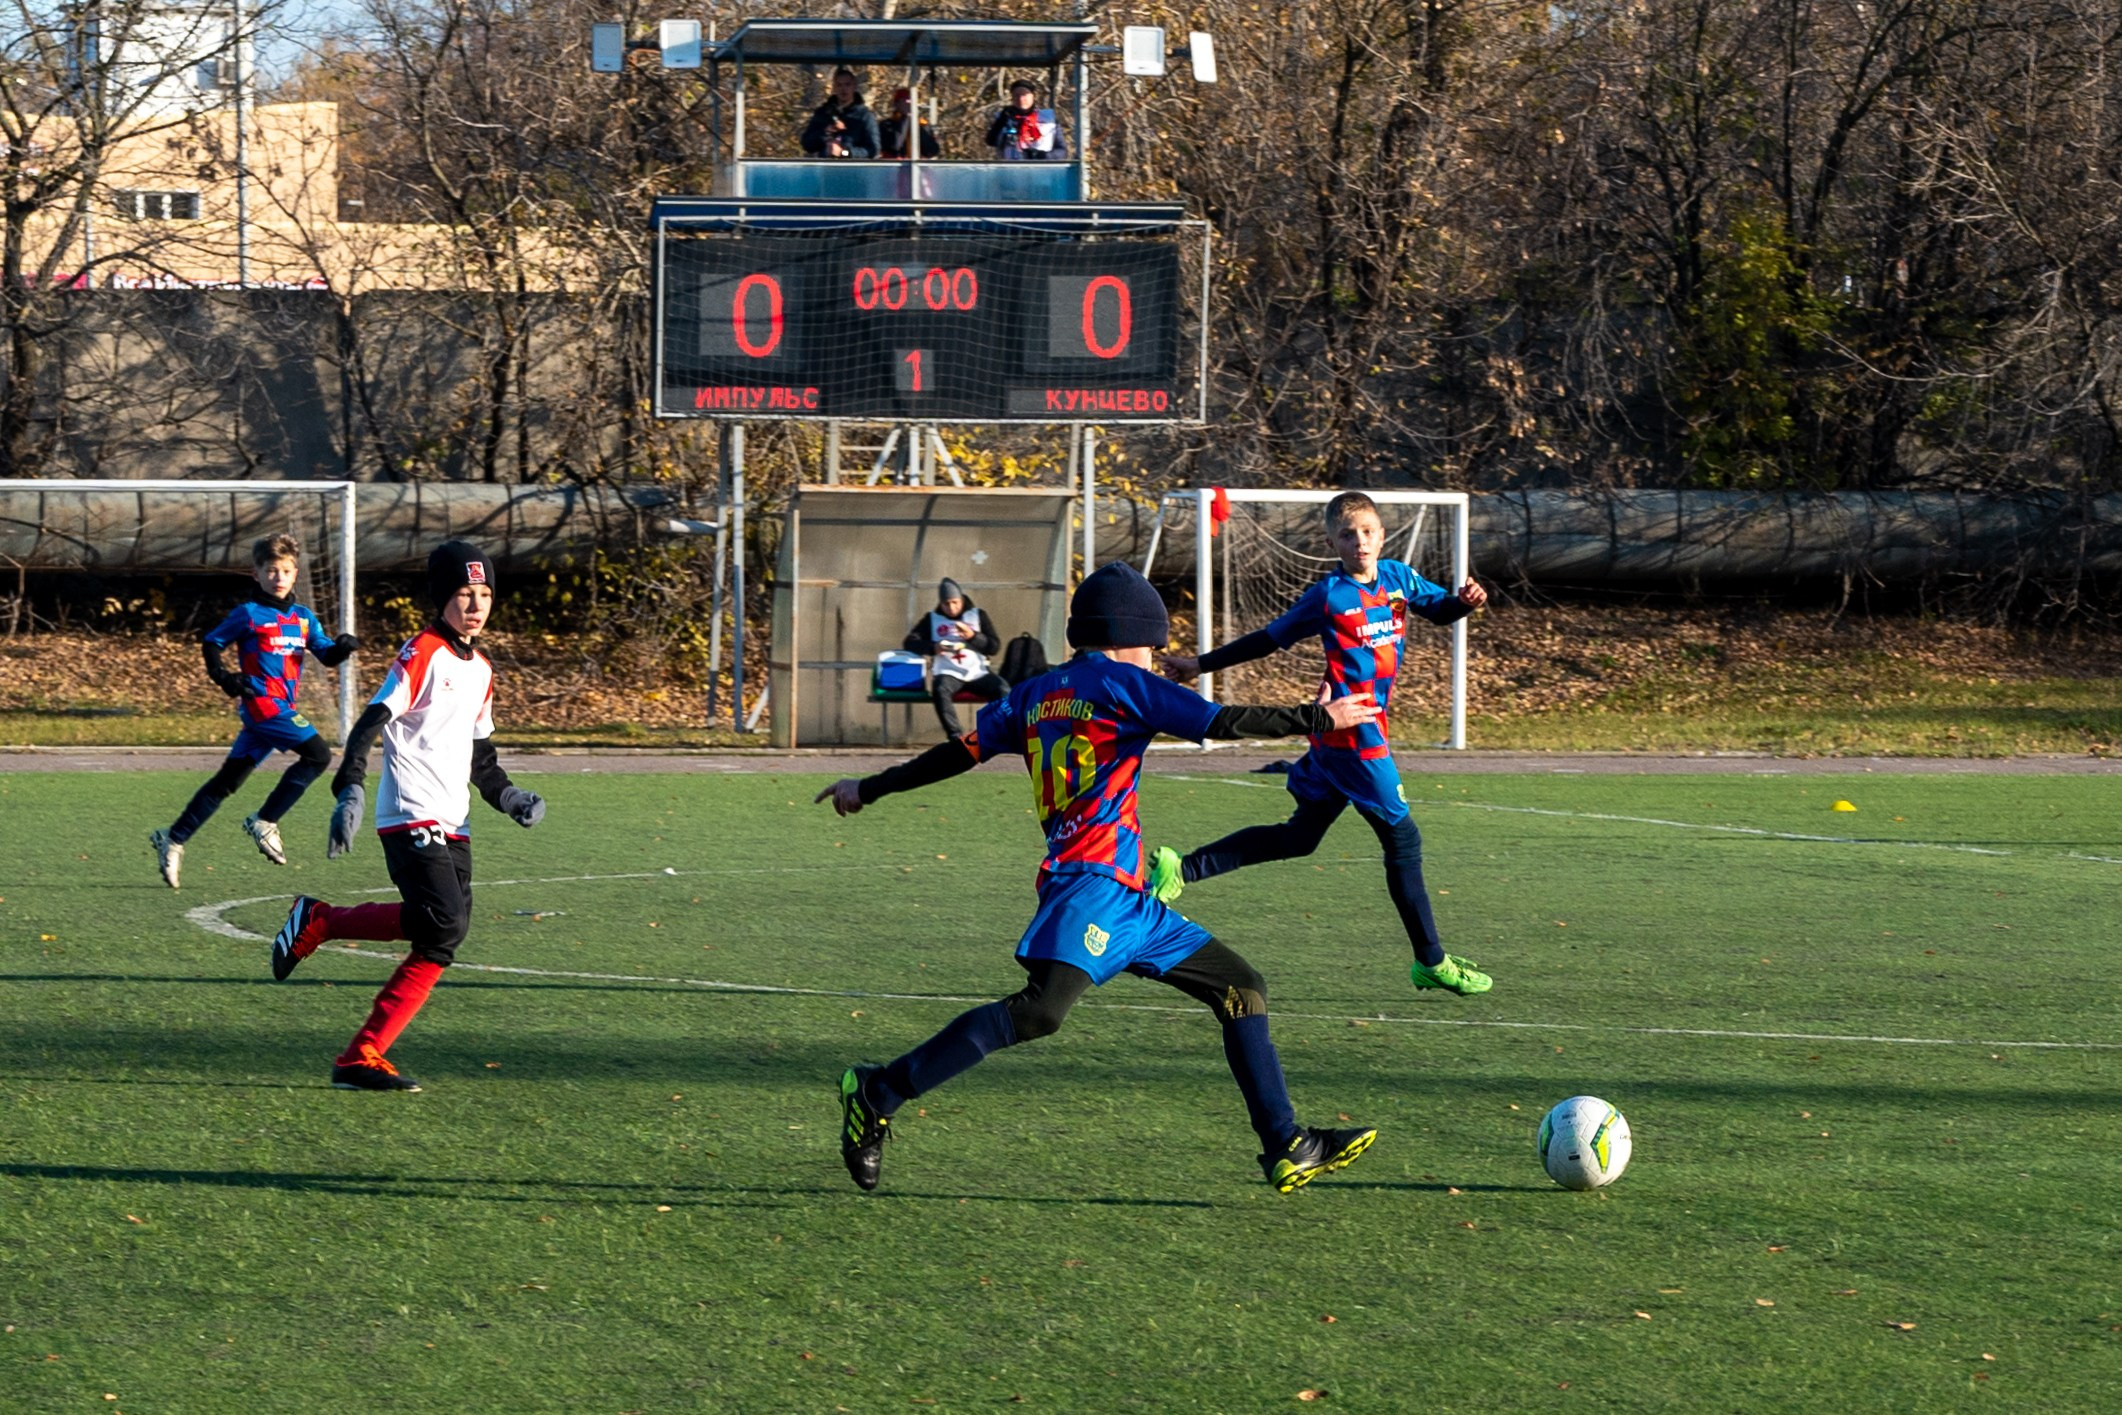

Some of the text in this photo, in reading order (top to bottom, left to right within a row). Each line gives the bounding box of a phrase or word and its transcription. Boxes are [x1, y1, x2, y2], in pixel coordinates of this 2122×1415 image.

[854, 267, 978, 310] 00:00
[732, 274, 783, 357] 0
[1082, 275, 1132, 358] 0
[904, 349, 922, 391] 1
[695, 386, 818, 409] ИМПУЛЬС
[1045, 389, 1168, 411] КУНЦЕВО
[1356, 618, 1402, 638] IMPULS
[1026, 697, 1095, 727] КОСТИКОВ
[1027, 733, 1097, 822] 10
